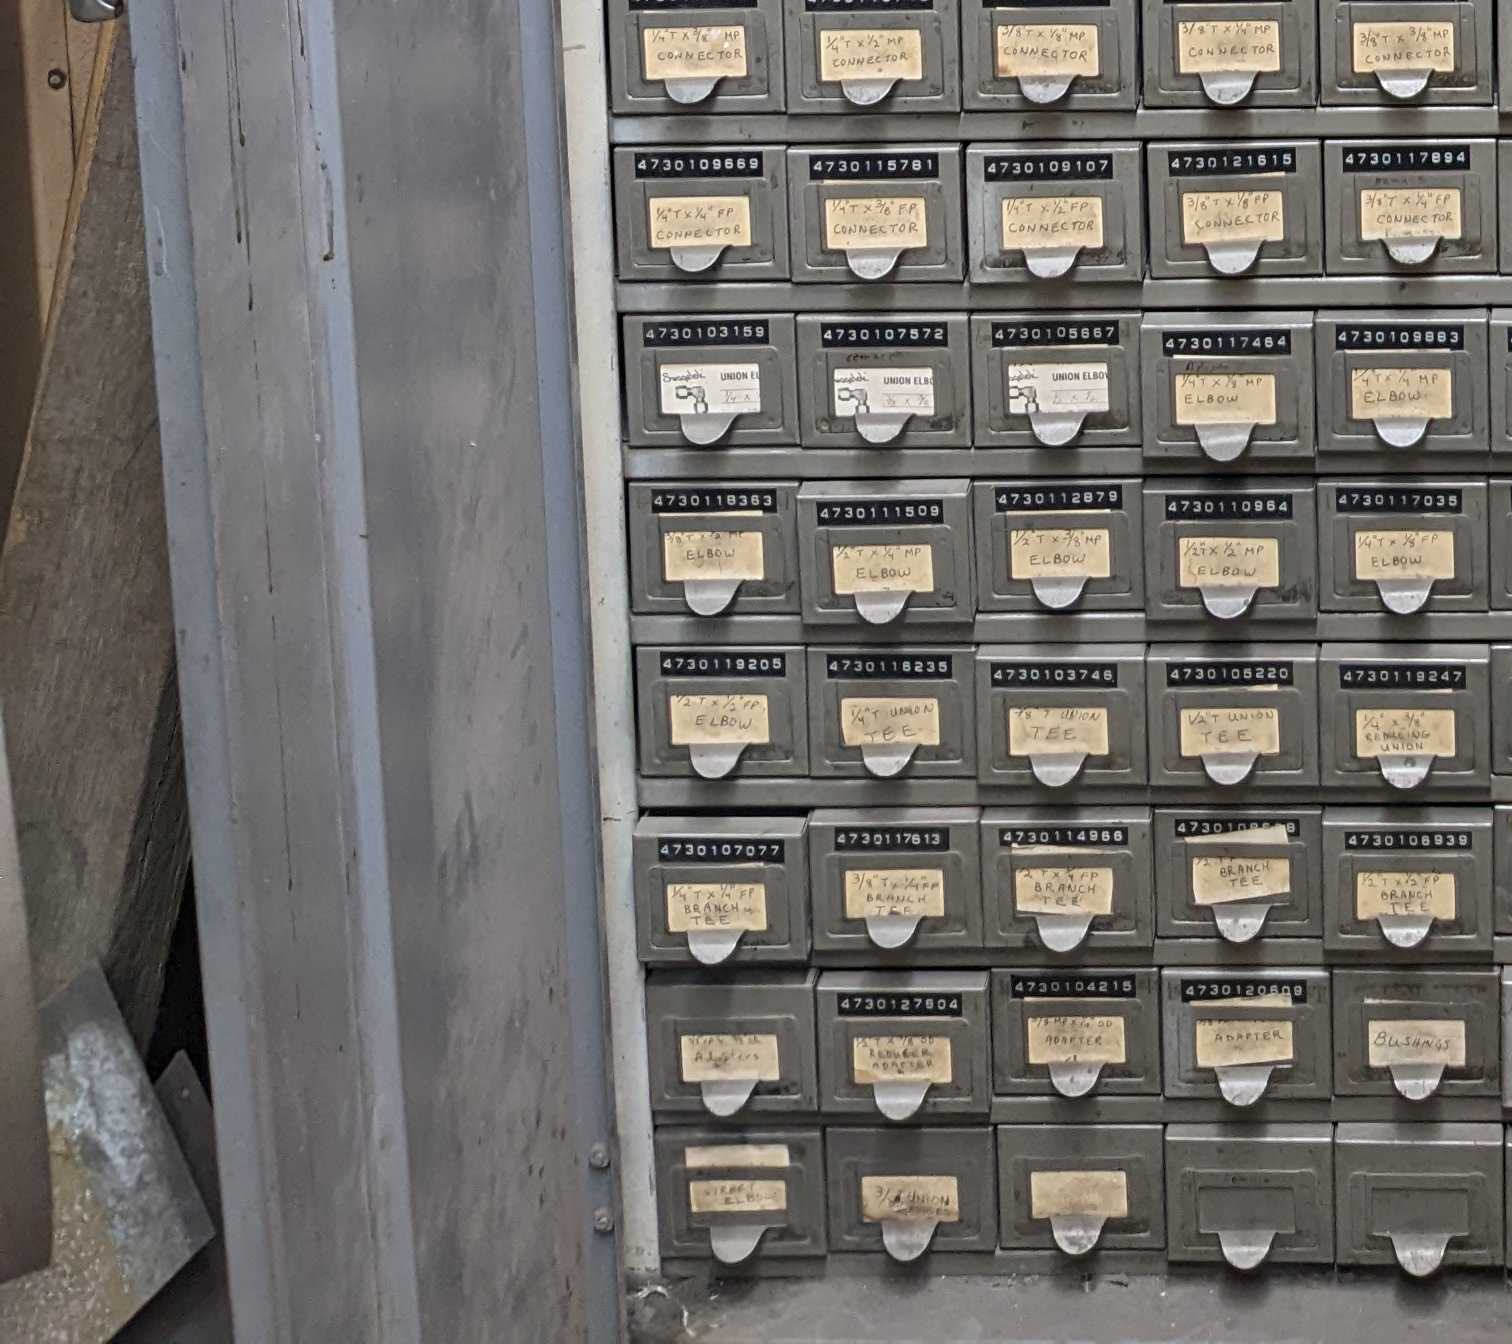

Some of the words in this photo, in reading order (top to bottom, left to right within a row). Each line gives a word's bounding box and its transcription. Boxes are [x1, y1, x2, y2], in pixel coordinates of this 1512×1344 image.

[1171, 153, 1292, 168] 4730121615
[1344, 151, 1465, 165] 4730117894
[638, 159, 760, 171] 4730109669
[813, 159, 934, 173] 4730115781
[987, 159, 1109, 174] 4730109107
[646, 326, 765, 340] 4730103159
[823, 328, 944, 341] 4730107572
[994, 327, 1114, 340] 4730105667
[1337, 330, 1460, 344] 4730109883
[720, 371, 749, 382] UNION
[883, 376, 911, 385] UNION
[1052, 372, 1079, 381] UNION
[997, 492, 1119, 505] 4730112879
[1338, 493, 1457, 506] 4730117035
[1168, 500, 1288, 514] 4730110964
[663, 658, 782, 671] 4730119205
[1343, 670, 1462, 683] 4730119247
[660, 843, 780, 857] 4730107077
